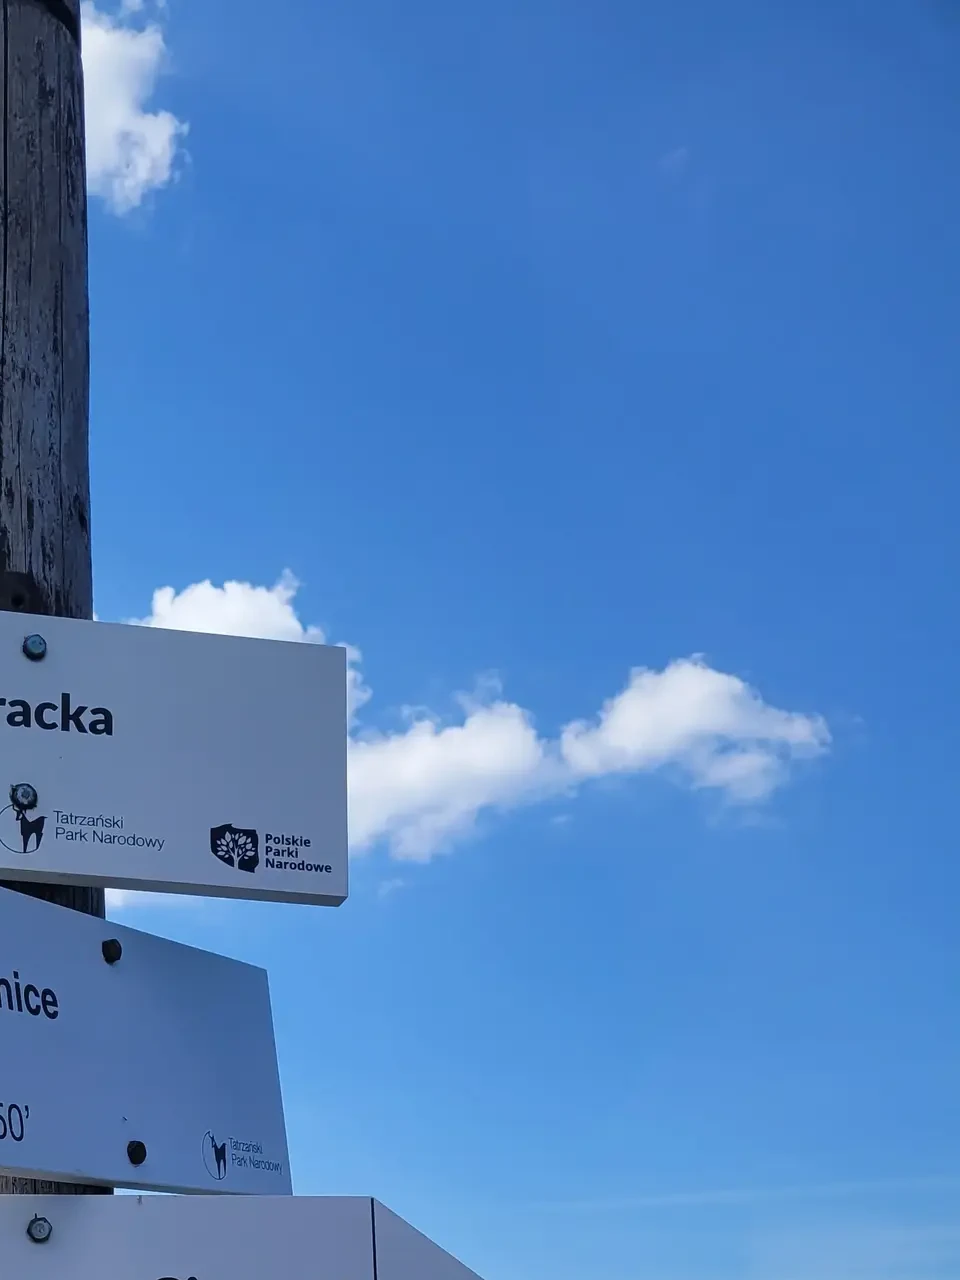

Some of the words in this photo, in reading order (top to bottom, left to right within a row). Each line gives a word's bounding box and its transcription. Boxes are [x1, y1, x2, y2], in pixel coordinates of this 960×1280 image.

[53, 810, 124, 830] Tatrzański
[55, 826, 89, 842] Park
[92, 829, 166, 852] Narodowy
[265, 833, 311, 848] Polskie
[265, 846, 299, 860] Parki
[265, 859, 332, 874] Narodowe
